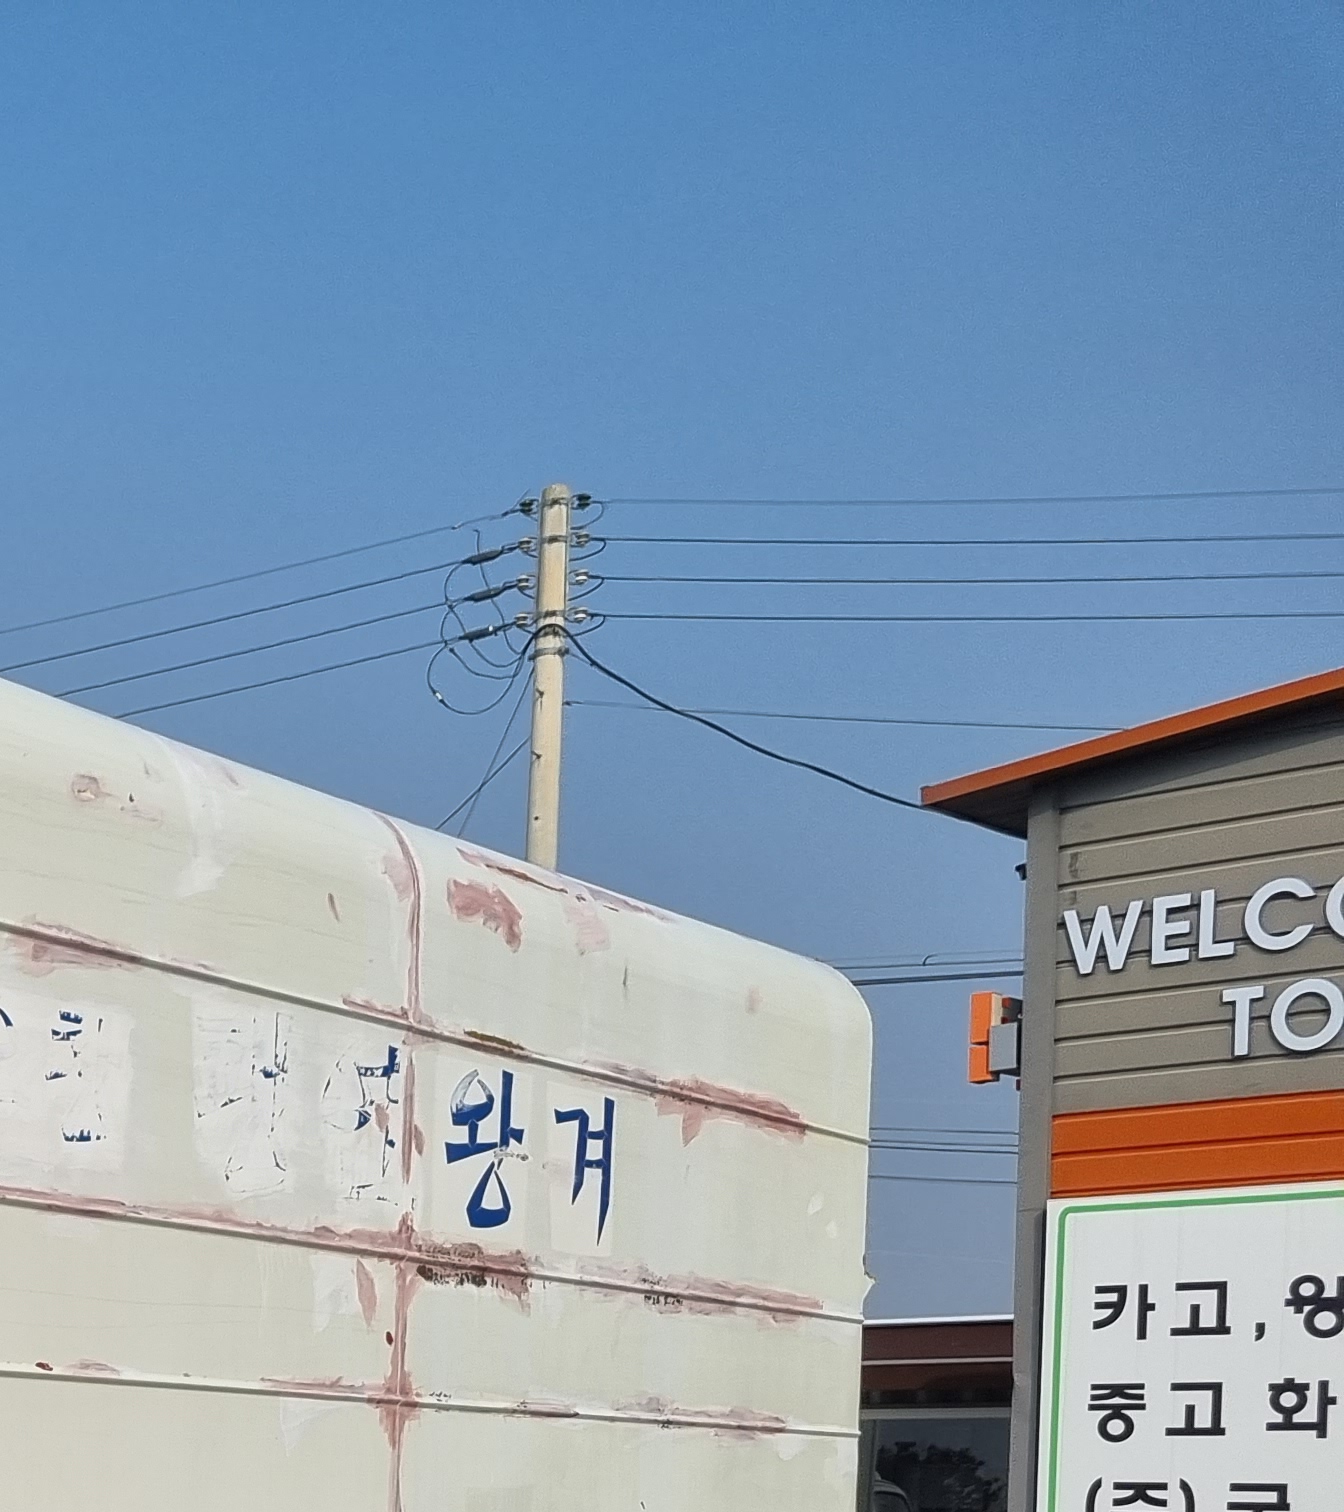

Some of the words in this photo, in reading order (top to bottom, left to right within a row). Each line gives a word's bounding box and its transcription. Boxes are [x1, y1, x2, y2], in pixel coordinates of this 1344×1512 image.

[1064, 877, 1344, 974] WELC
[1222, 978, 1344, 1056] TO
[1087, 1381, 1227, 1443] 중고
